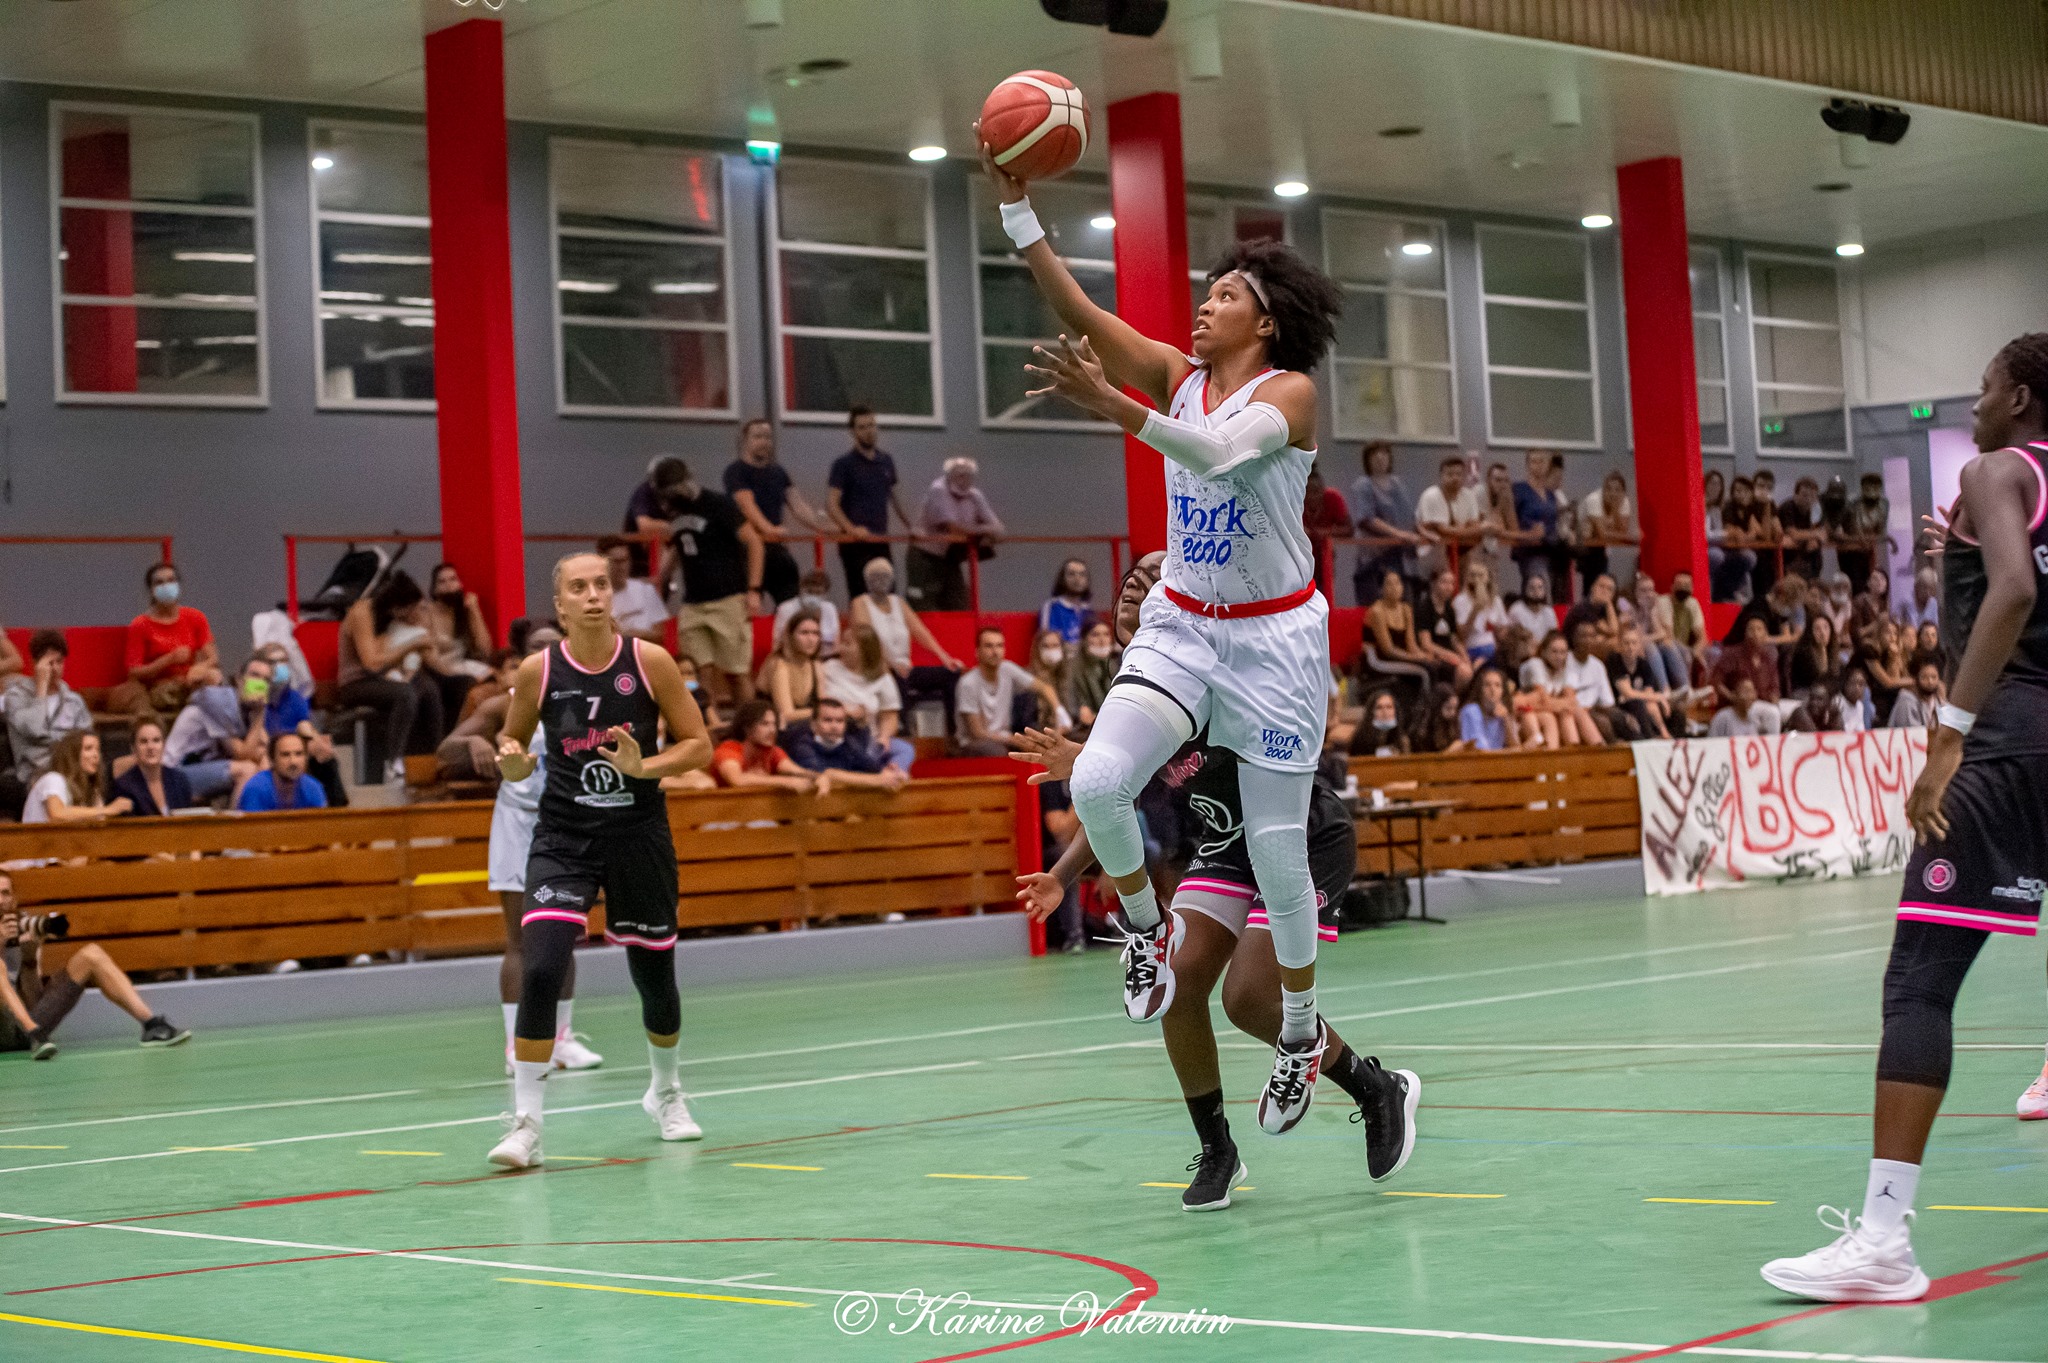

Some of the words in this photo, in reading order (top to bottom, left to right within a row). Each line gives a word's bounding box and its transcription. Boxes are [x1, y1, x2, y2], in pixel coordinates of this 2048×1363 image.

[1182, 537, 1232, 566] 2000
[586, 696, 602, 720] 7
[1262, 728, 1302, 751] Work
[1264, 746, 1293, 760] 2000
